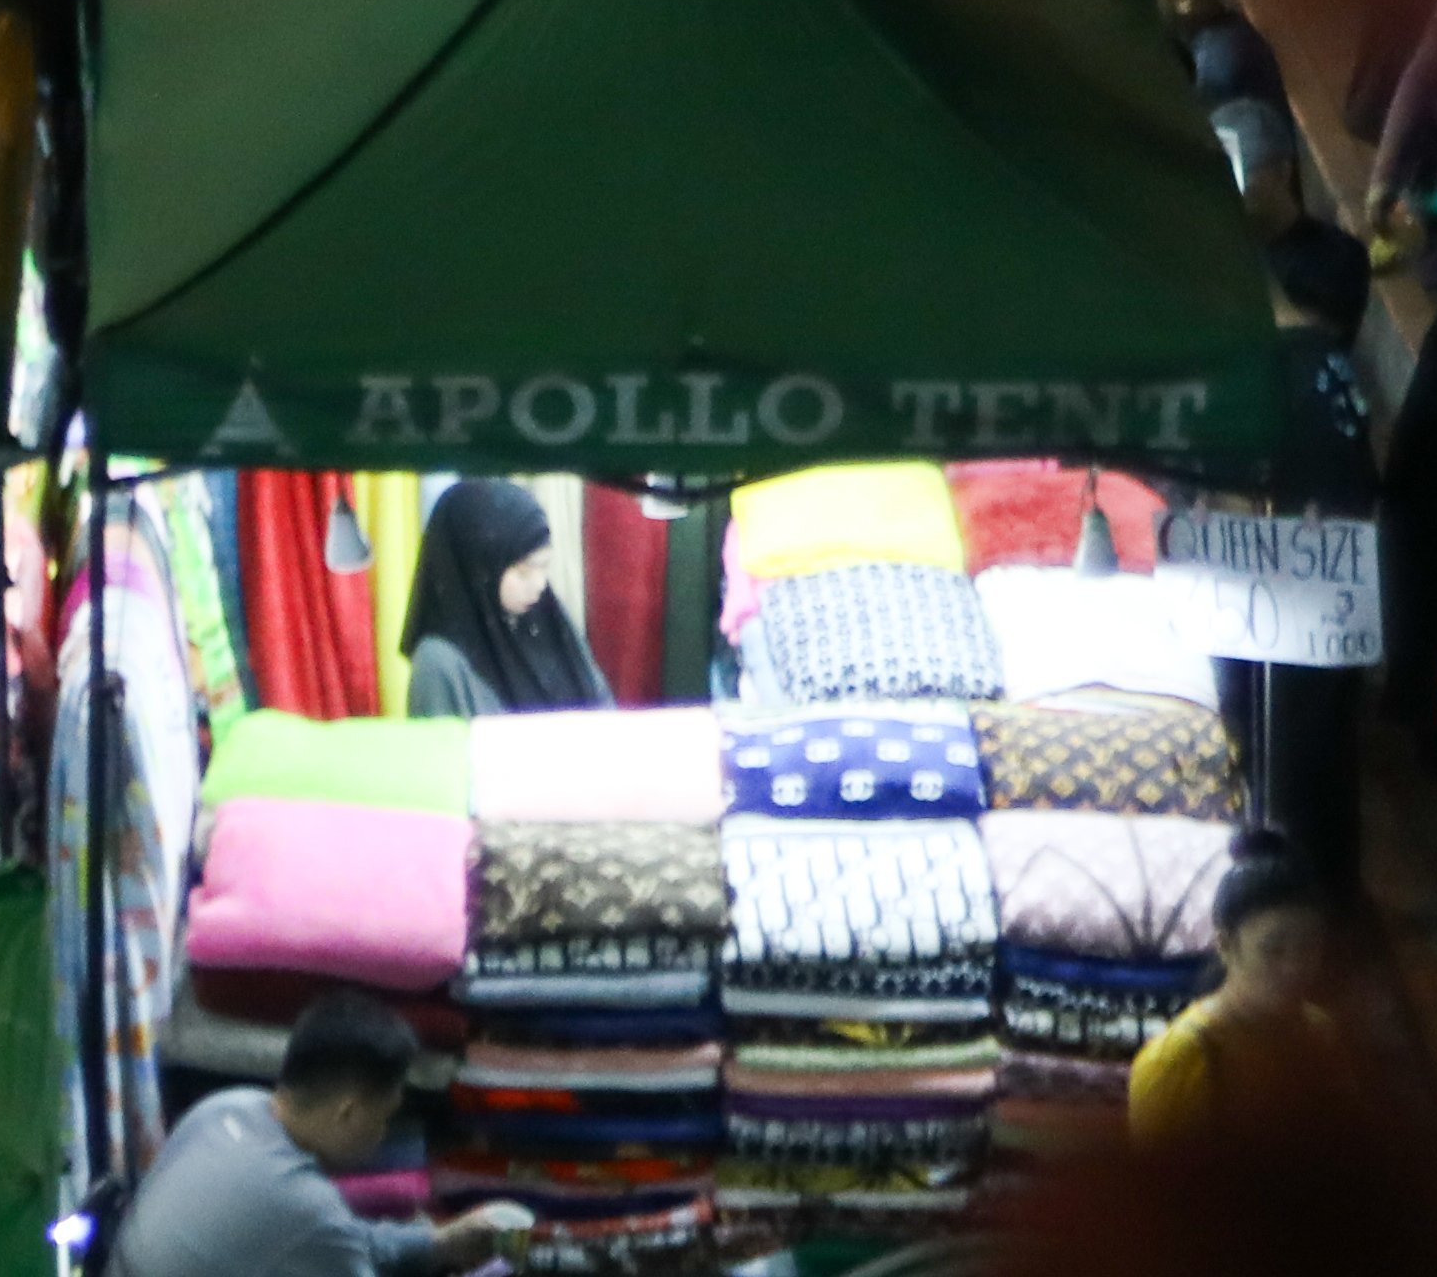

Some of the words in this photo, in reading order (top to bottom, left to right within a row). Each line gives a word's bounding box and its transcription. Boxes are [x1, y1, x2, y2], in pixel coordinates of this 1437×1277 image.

[354, 372, 845, 445] APOLLO
[891, 380, 1208, 447] TENT
[1290, 524, 1367, 585] SIZE
